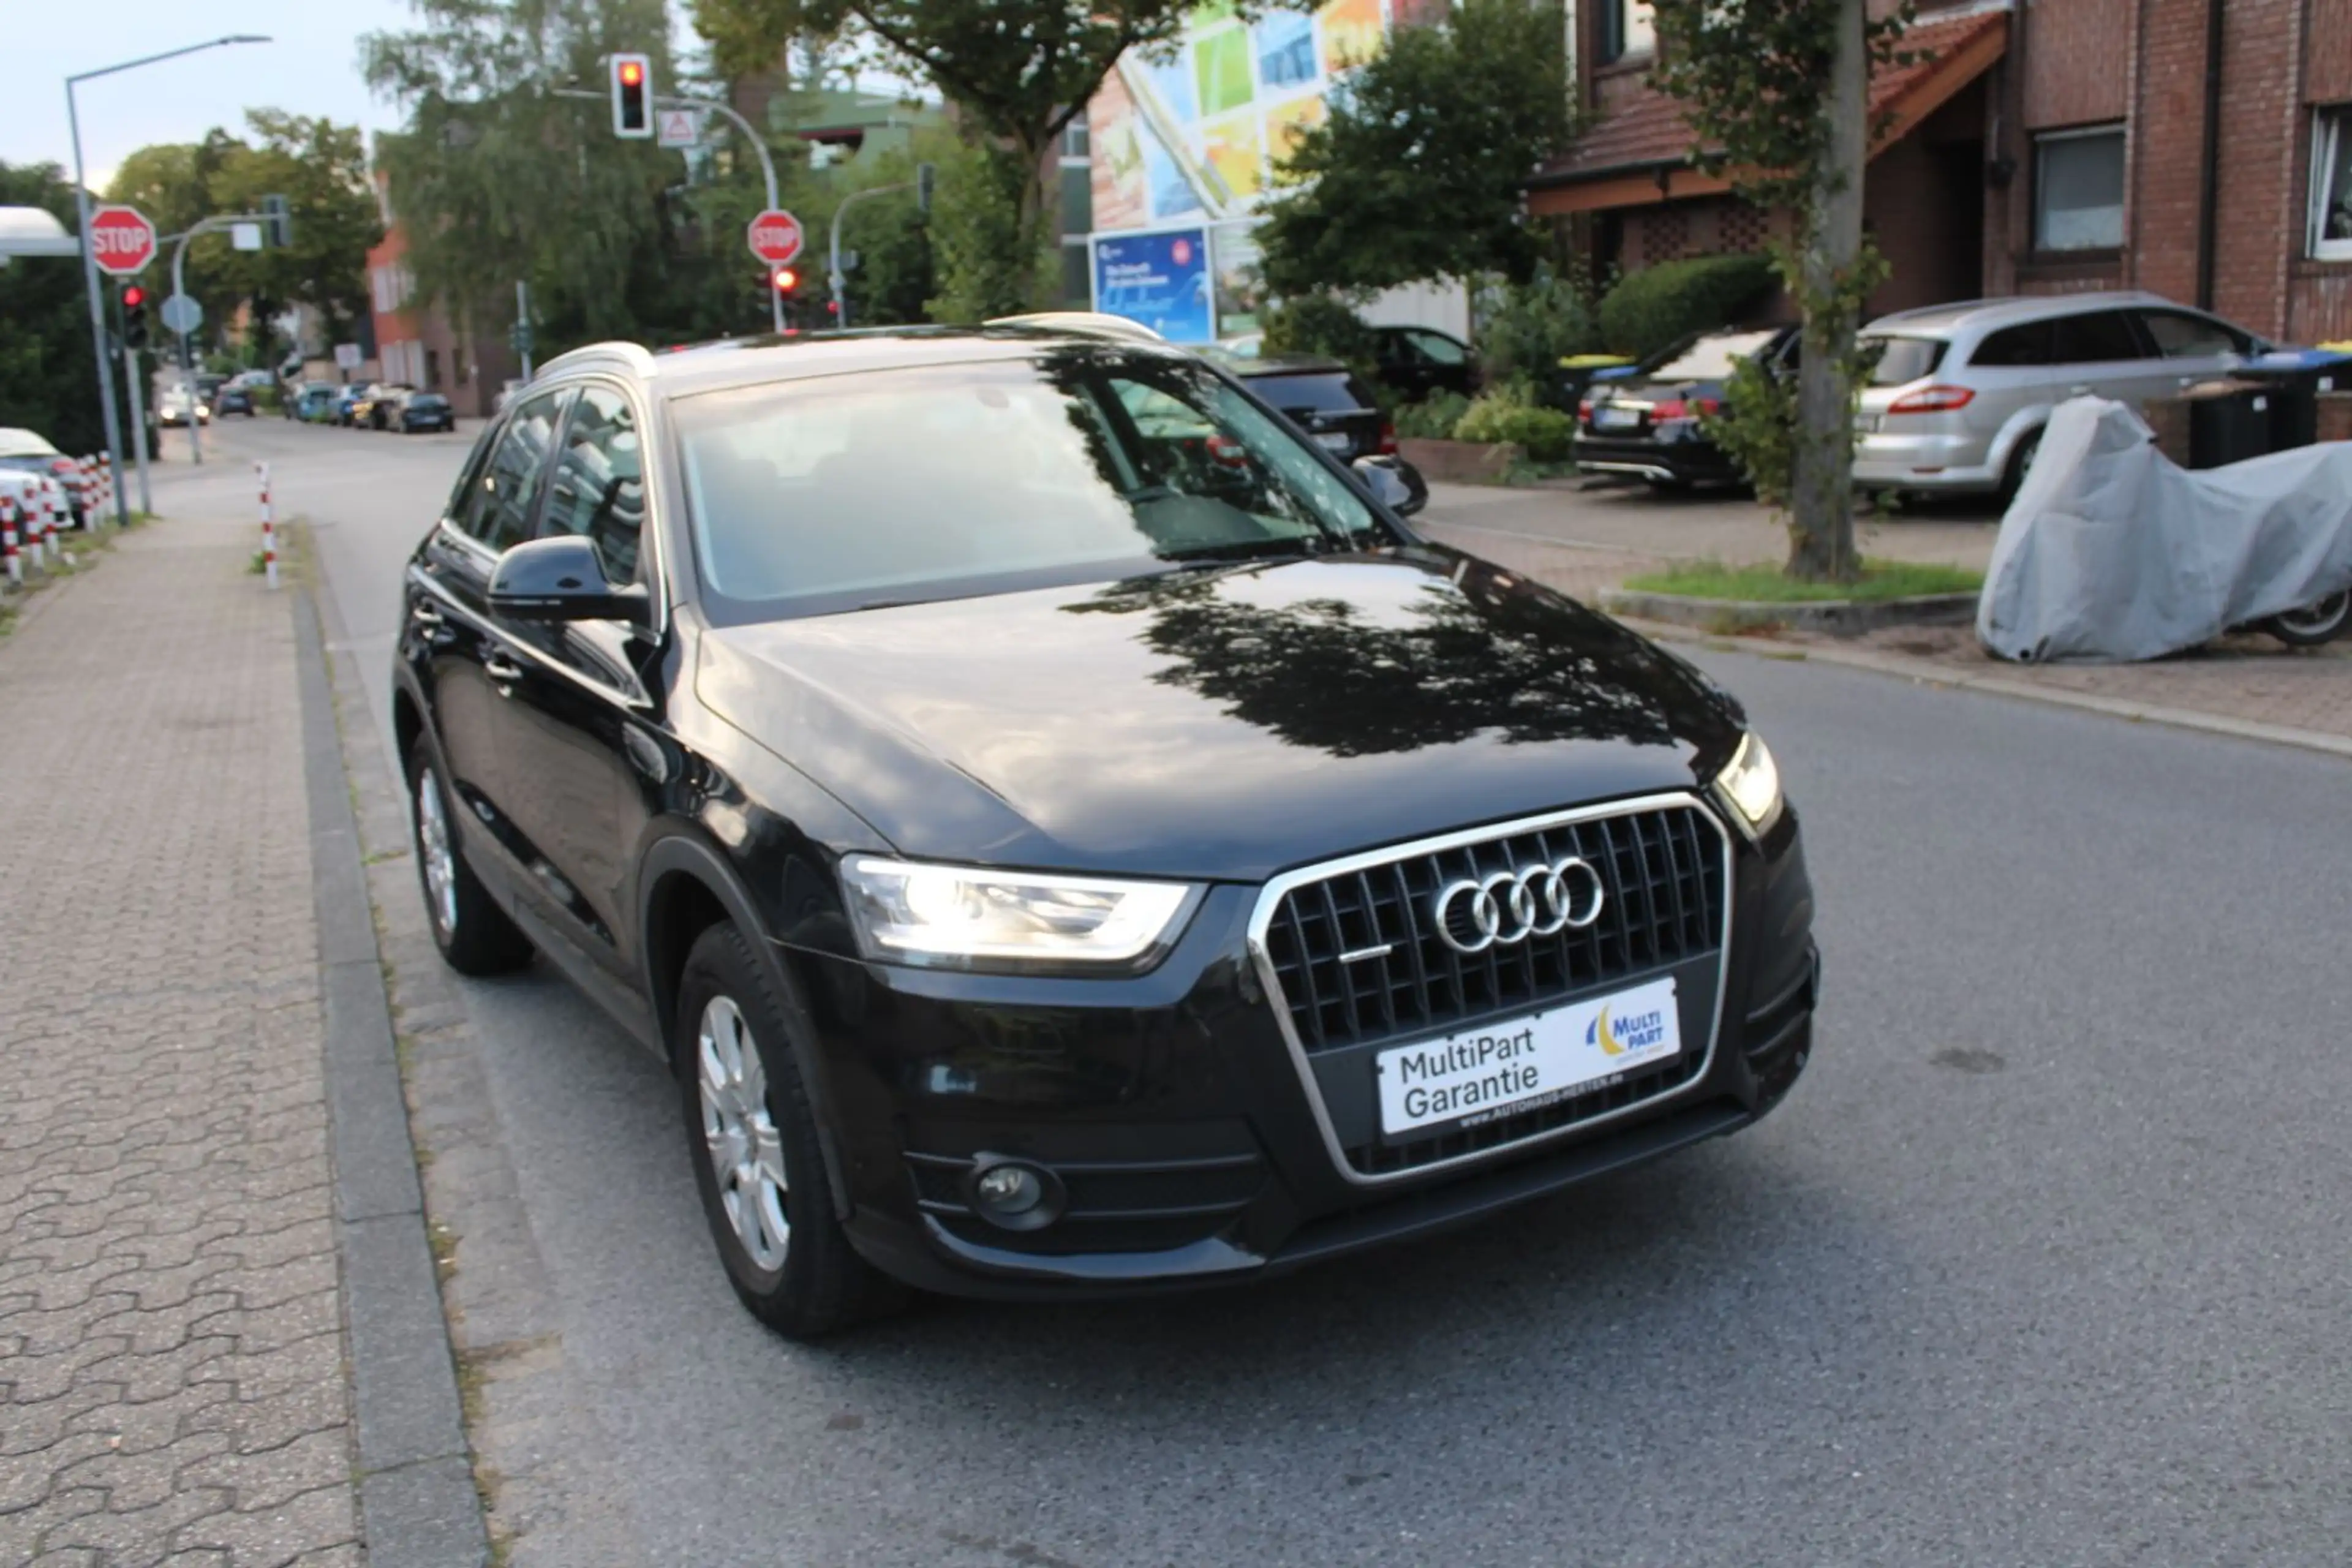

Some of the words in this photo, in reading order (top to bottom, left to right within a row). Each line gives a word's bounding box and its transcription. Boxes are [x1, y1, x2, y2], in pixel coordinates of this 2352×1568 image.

[91, 227, 147, 254] STOP
[755, 227, 796, 247] STOP
[1613, 1011, 1660, 1038] MULTI
[1627, 1026, 1664, 1050] PART
[1400, 1027, 1536, 1085] MultiPart
[1404, 1061, 1539, 1119] Garantie
